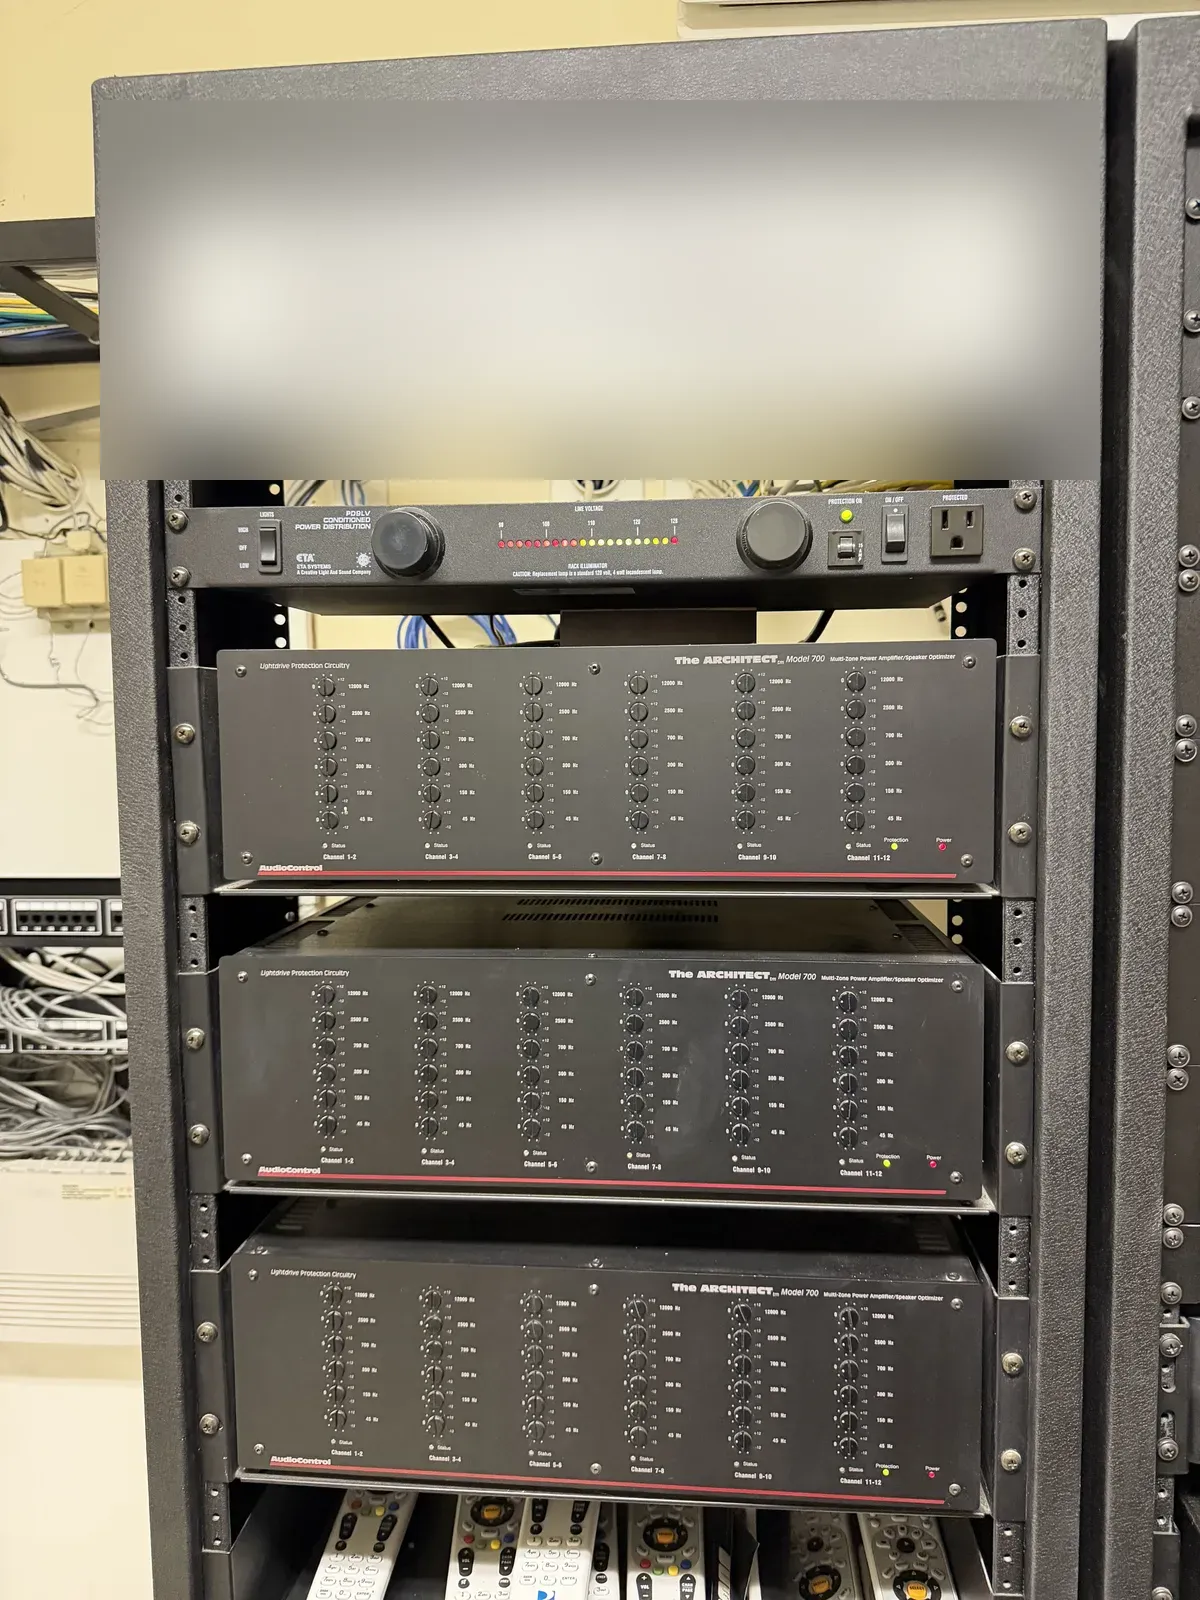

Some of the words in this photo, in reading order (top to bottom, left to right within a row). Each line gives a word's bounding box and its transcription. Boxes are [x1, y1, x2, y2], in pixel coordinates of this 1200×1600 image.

[674, 656, 700, 664] The
[703, 655, 779, 664] ARCHITECT
[668, 970, 693, 978] The
[697, 971, 771, 979] ARCHITECT
[258, 1166, 321, 1175] AudioControl
[332, 1271, 356, 1279] Circuitry
[672, 1283, 697, 1292] The
[700, 1284, 775, 1295] ARCHITECT
[781, 1288, 804, 1296] Model
[270, 1456, 331, 1466] AudioControl
